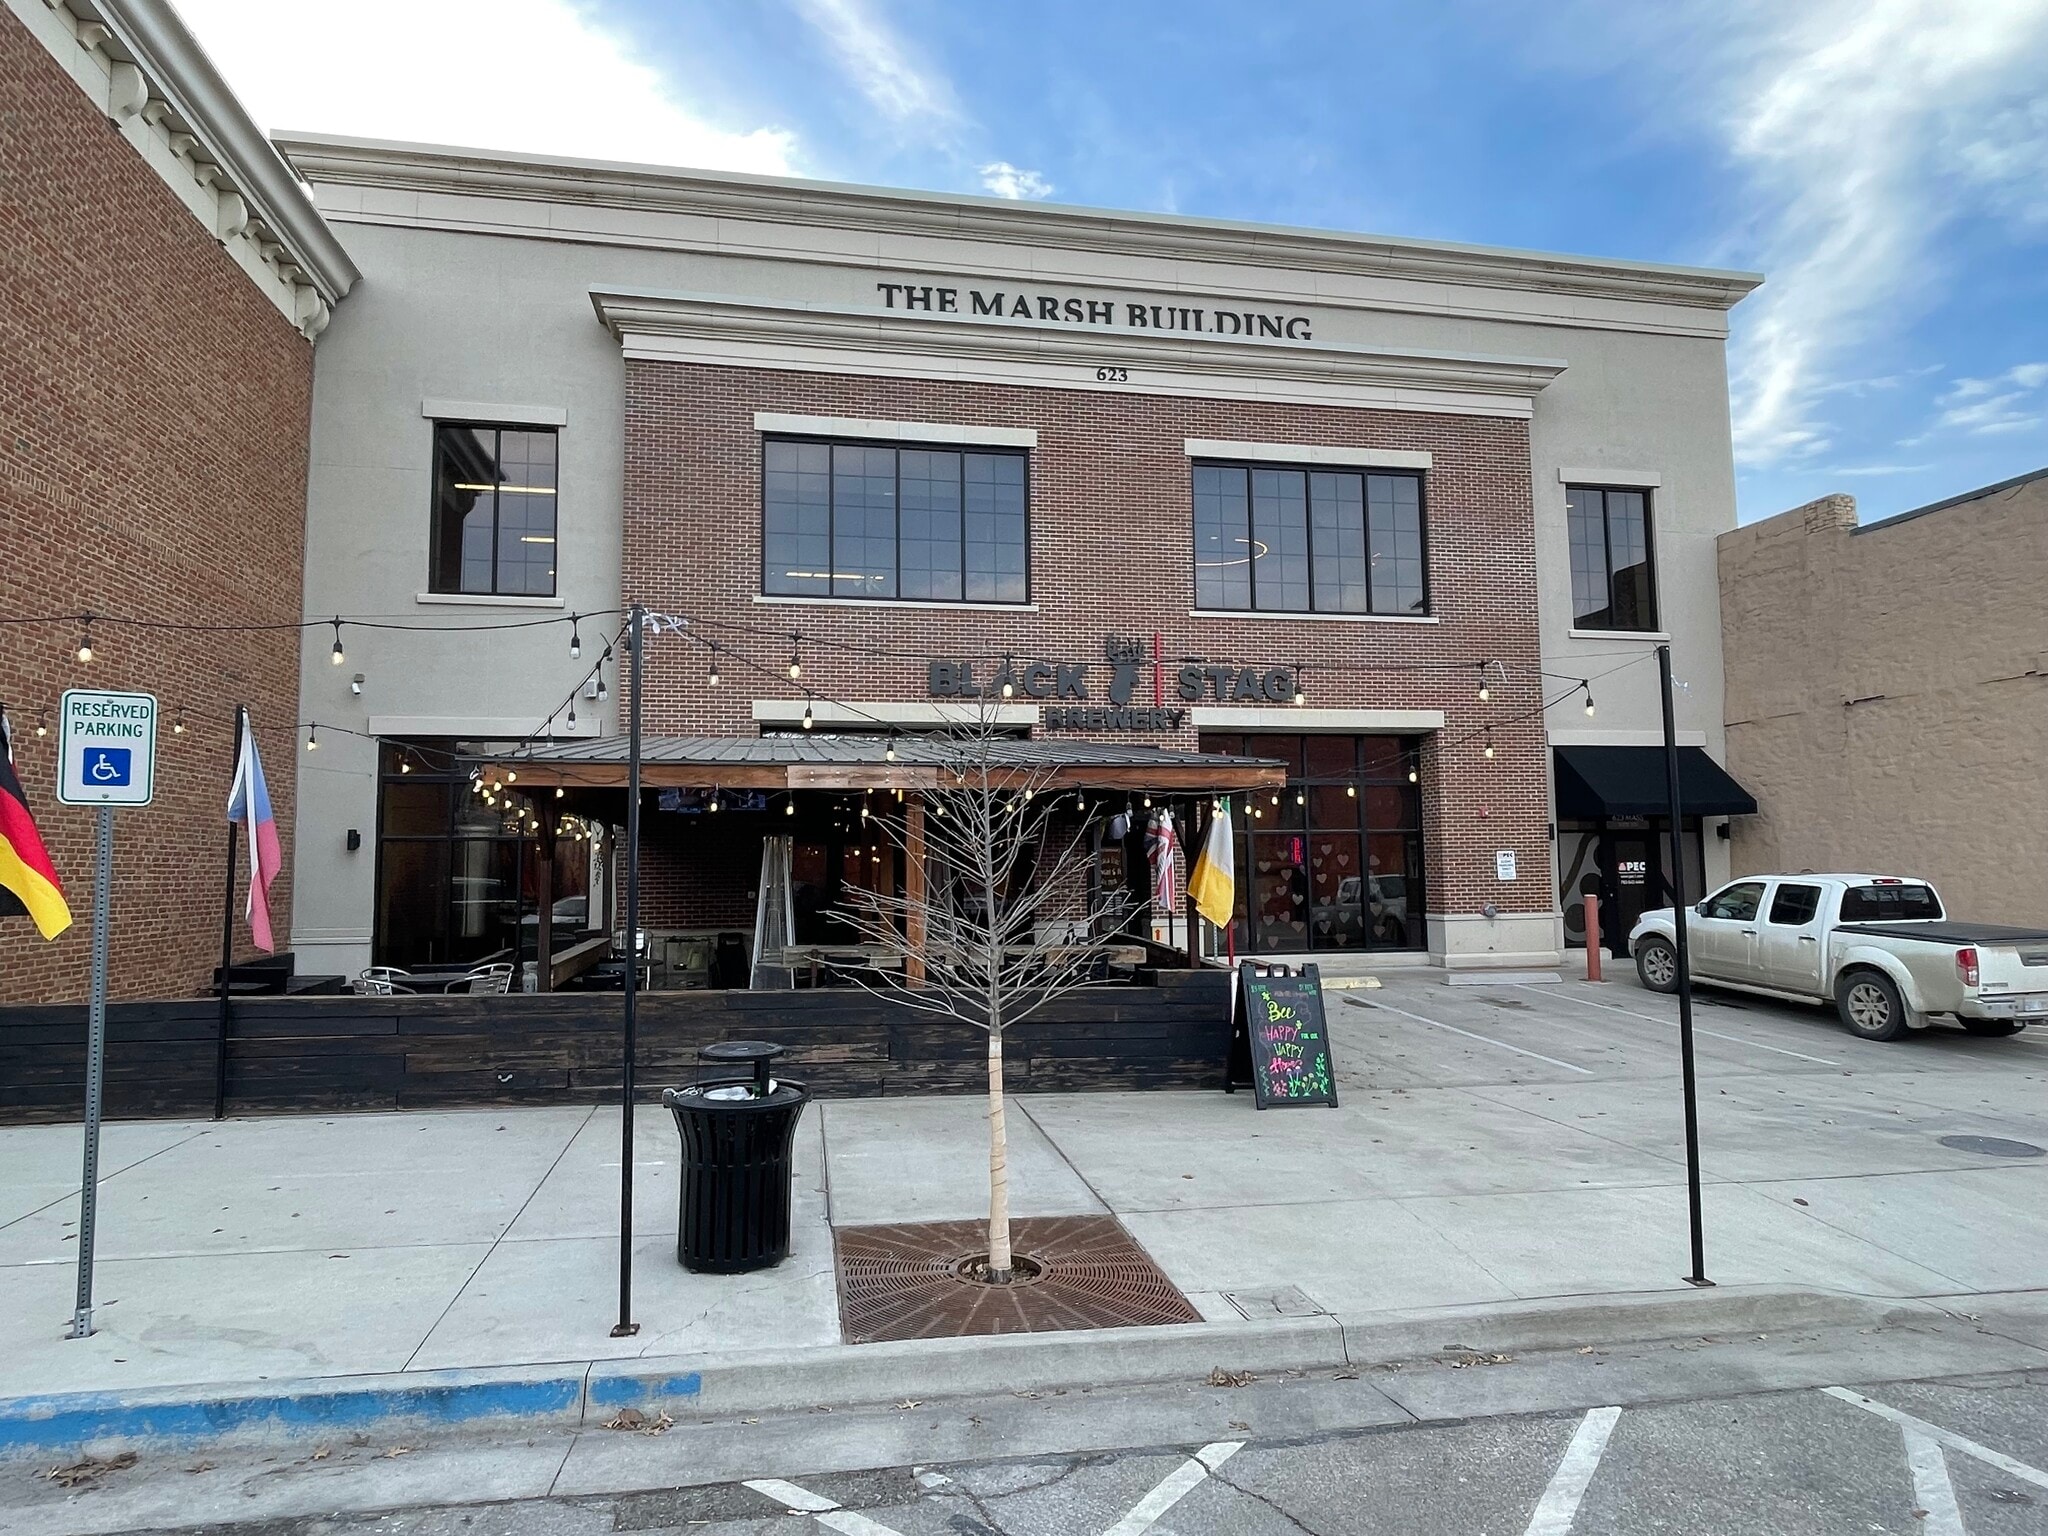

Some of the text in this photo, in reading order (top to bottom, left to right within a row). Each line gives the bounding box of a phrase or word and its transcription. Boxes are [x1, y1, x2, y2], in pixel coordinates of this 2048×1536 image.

[877, 283, 1313, 341] THE MARSH BUILDING
[1096, 367, 1128, 383] 623
[928, 661, 1294, 702] BLACK STAG
[71, 702, 150, 719] RESERVED
[1045, 707, 1185, 731] BREWERY
[74, 721, 143, 738] PARKING
[1266, 1000, 1296, 1022] Bee
[1264, 1025, 1298, 1042] HAPPY
